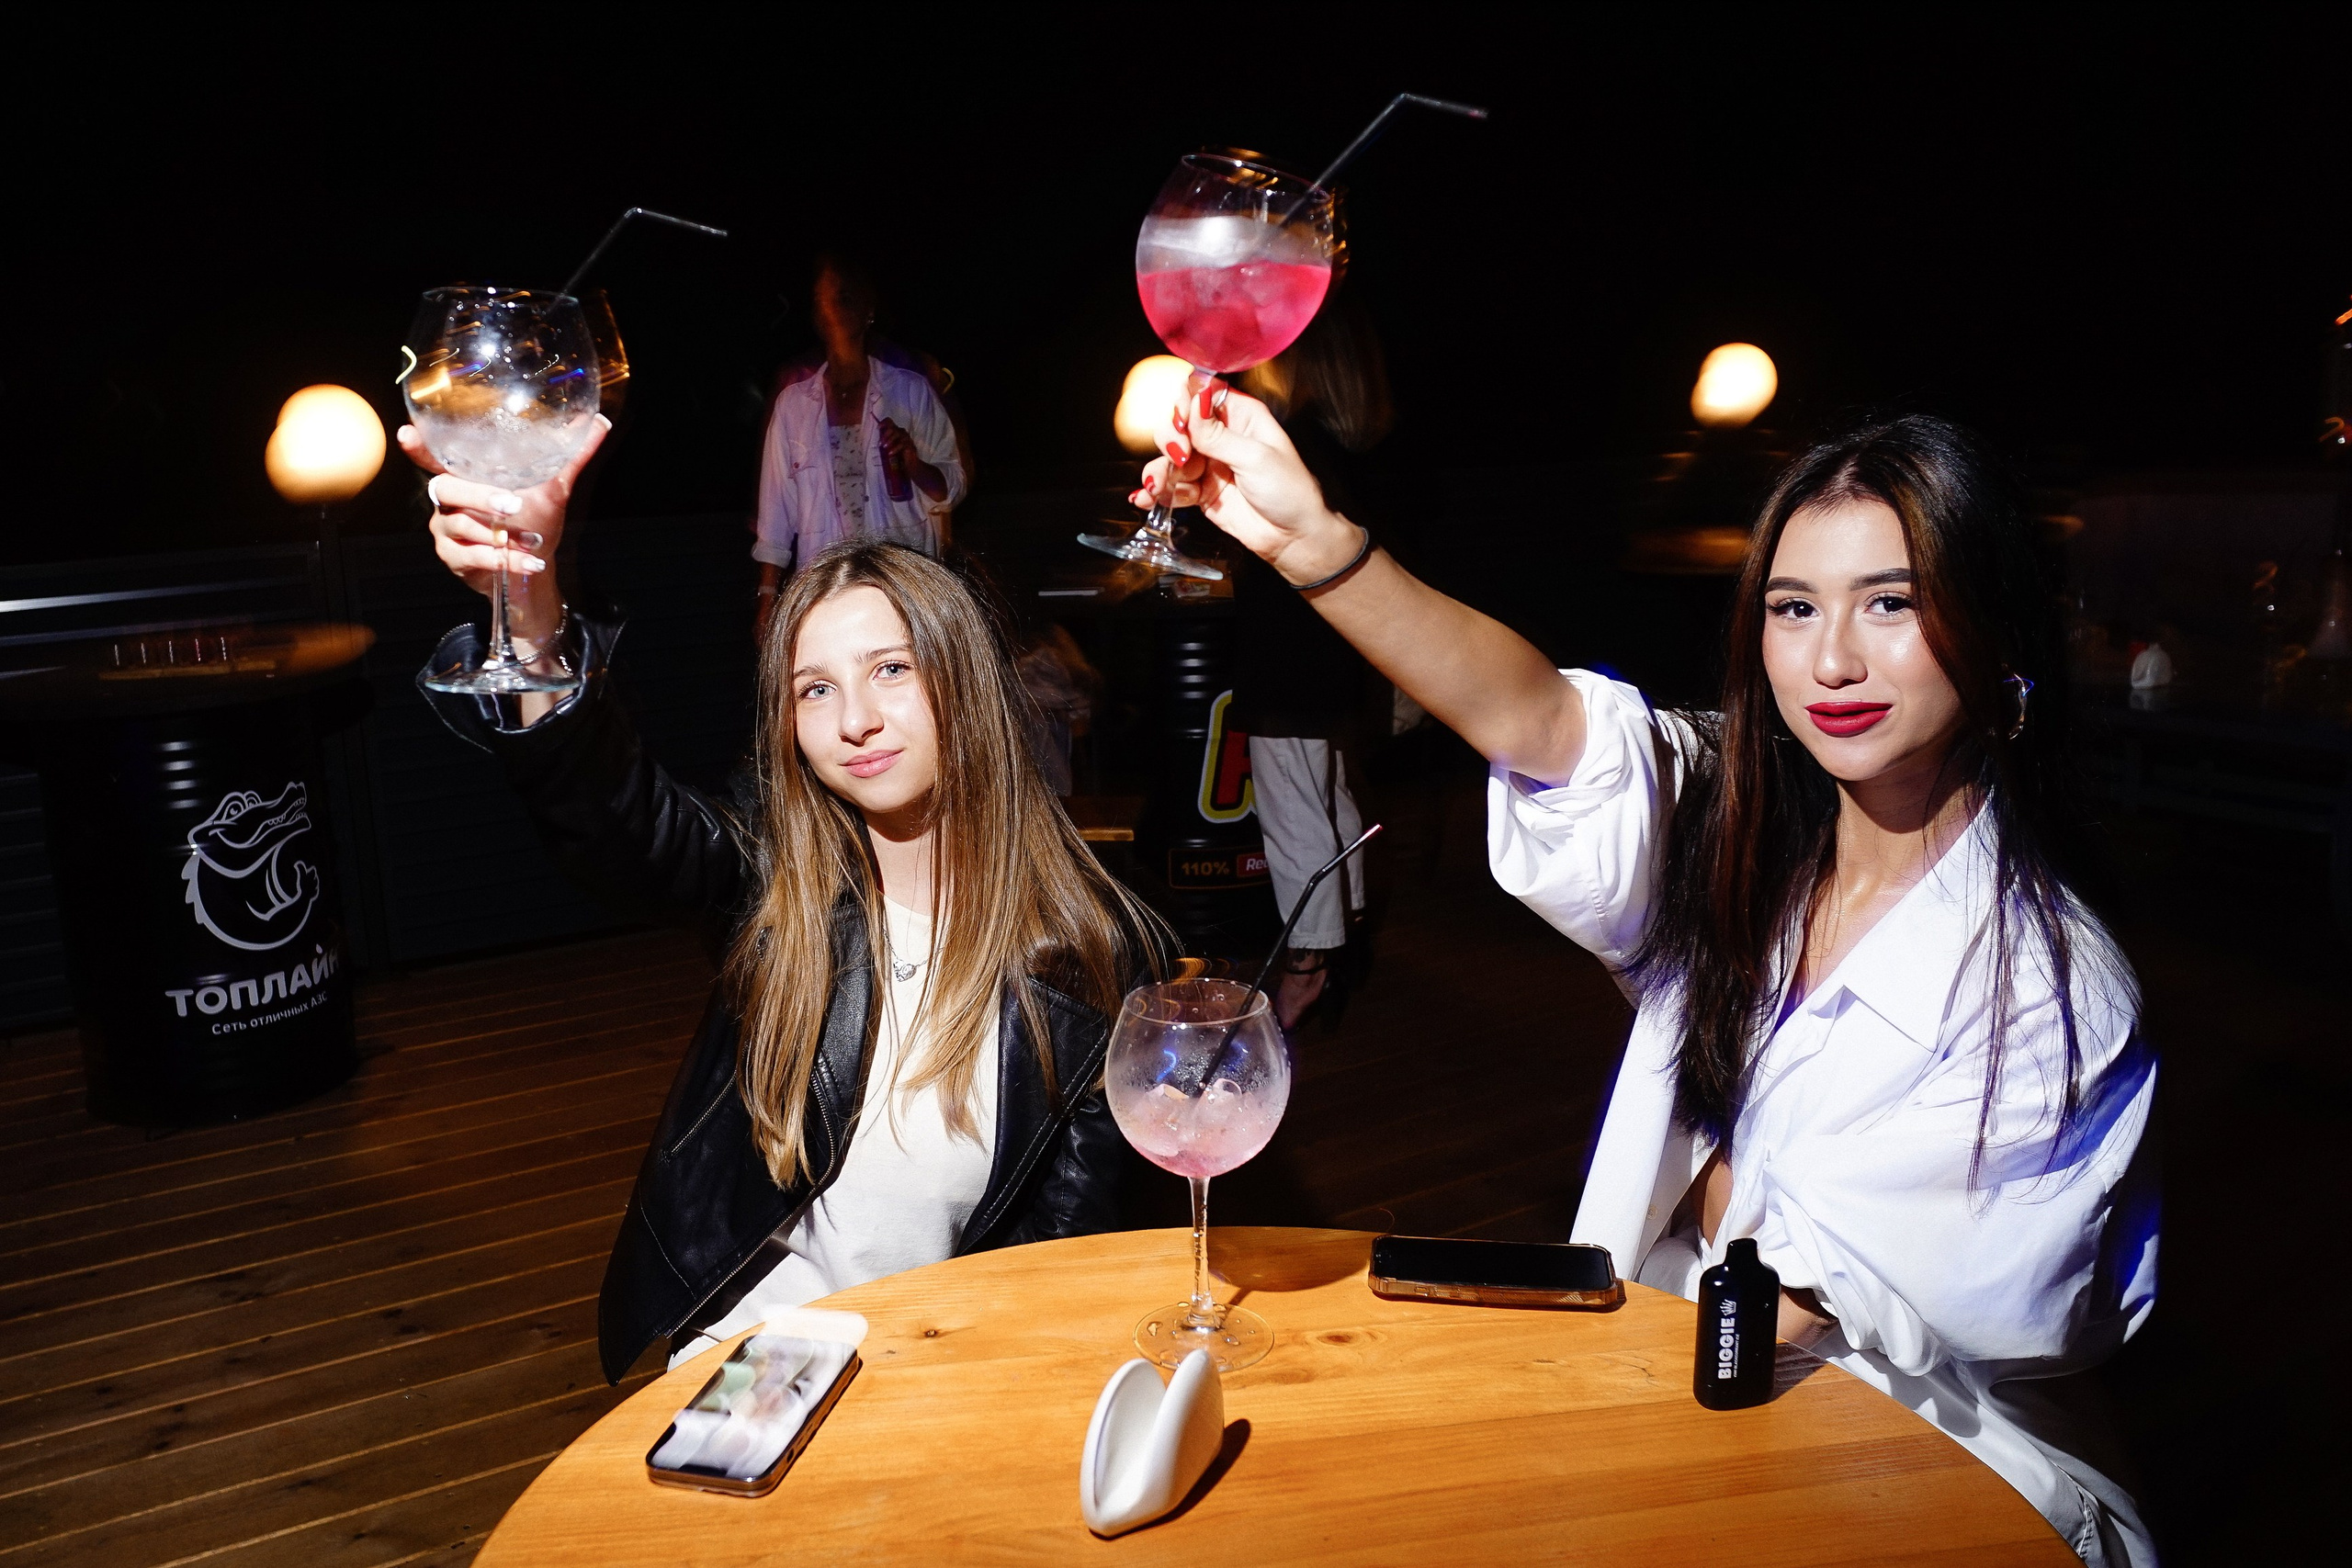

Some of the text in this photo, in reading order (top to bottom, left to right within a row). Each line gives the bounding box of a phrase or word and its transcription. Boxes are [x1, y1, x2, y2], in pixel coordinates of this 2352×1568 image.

[1181, 861, 1230, 876] 110%
[164, 943, 340, 1018] ТОПЛАЙН
[211, 990, 328, 1035] Сеть отличных АЗС
[1718, 1317, 1736, 1379] BIGGIE
